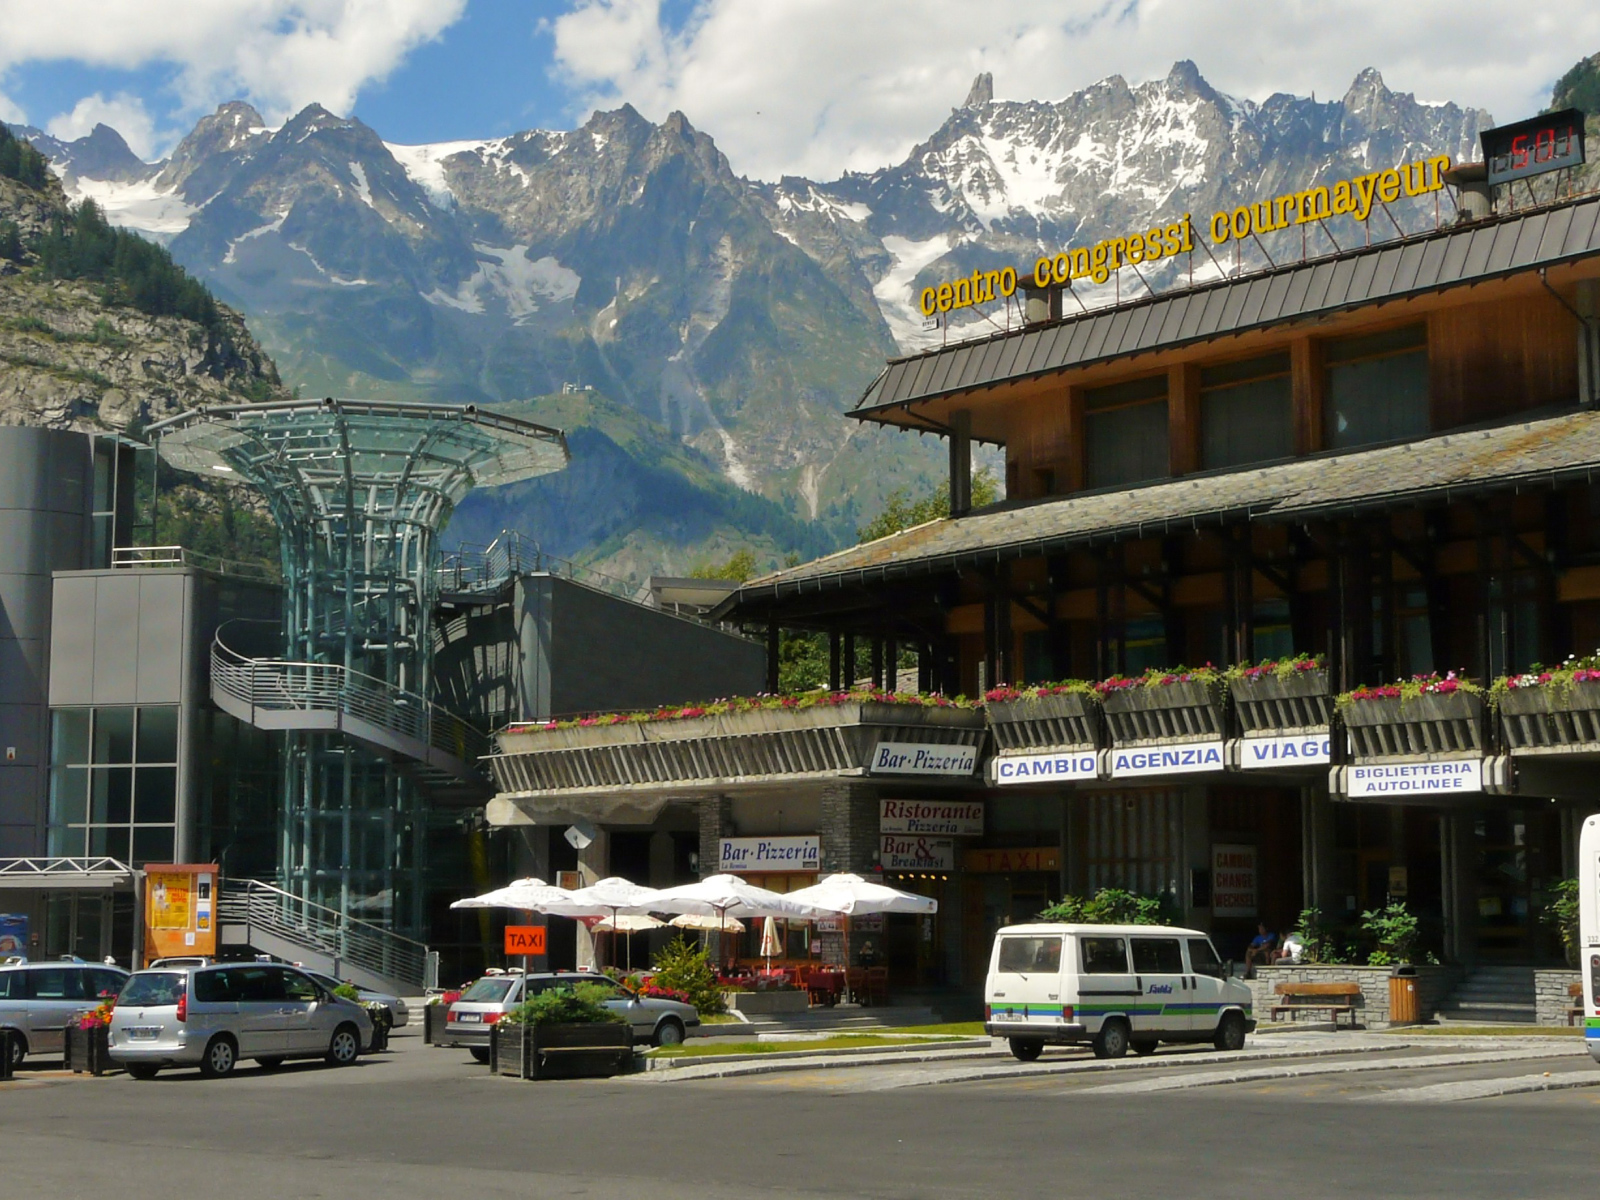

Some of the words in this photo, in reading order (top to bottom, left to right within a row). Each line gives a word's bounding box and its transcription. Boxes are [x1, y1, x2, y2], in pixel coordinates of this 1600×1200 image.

[919, 265, 1018, 317] centro
[1033, 212, 1196, 284] congressi
[1210, 153, 1451, 243] courmayeur
[877, 747, 907, 768] Bar
[911, 749, 974, 771] Pizzeria
[1000, 757, 1096, 777] CAMBIO
[1115, 748, 1221, 770] AGENZIA
[1355, 763, 1473, 779] BIGLIETTERIA
[1365, 777, 1464, 792] AUTOLINEE
[883, 800, 982, 820] Ristorante
[907, 819, 959, 833] Pizzeria
[722, 842, 749, 861] Bar
[756, 840, 818, 860] Pizzeria
[883, 836, 915, 854] Bar
[914, 837, 936, 861] &
[891, 854, 944, 869] Breakfast
[983, 852, 1041, 872] TAXI
[1215, 872, 1254, 888] CHANGE
[1214, 893, 1255, 908] WECHSEL
[508, 933, 543, 948] TAXI
